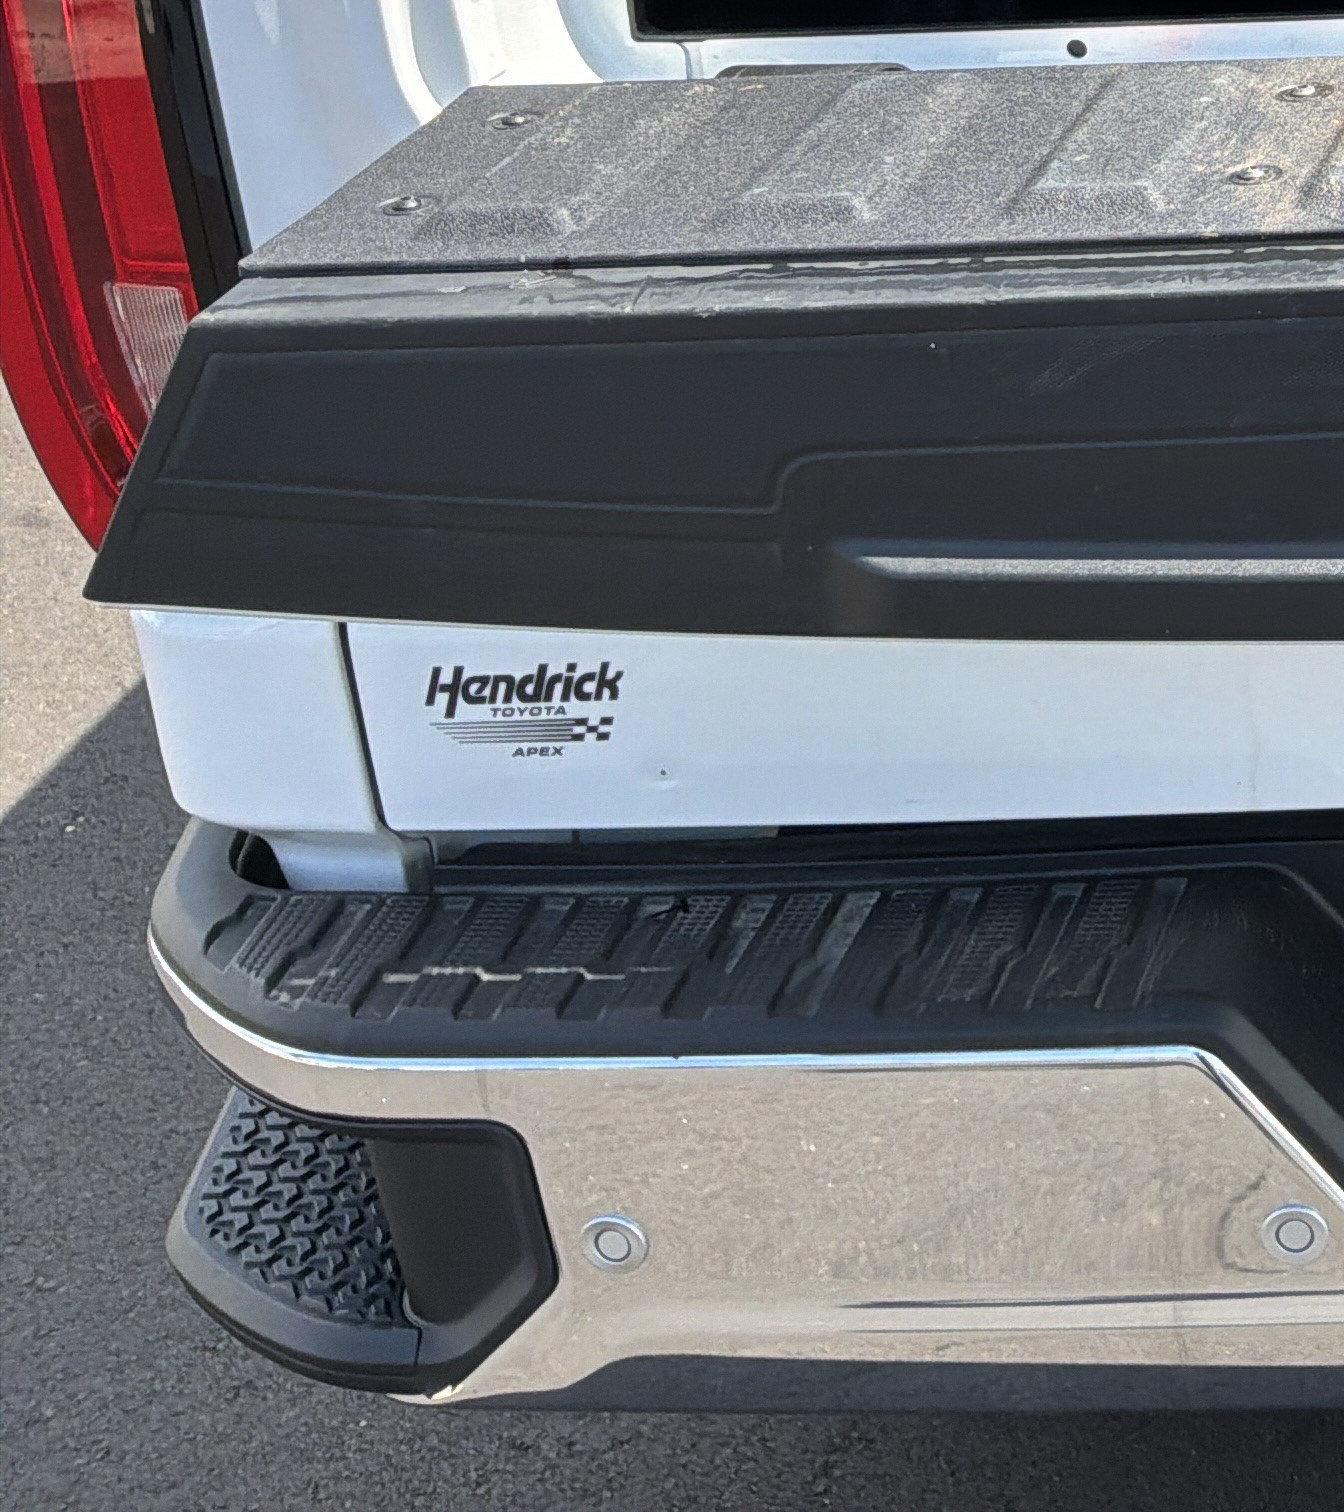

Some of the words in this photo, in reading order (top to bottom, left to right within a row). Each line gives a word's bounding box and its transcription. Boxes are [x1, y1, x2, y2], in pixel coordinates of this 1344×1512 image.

[425, 661, 625, 719] Hendrick
[490, 705, 567, 718] TOYOTA
[512, 746, 563, 758] APEX
